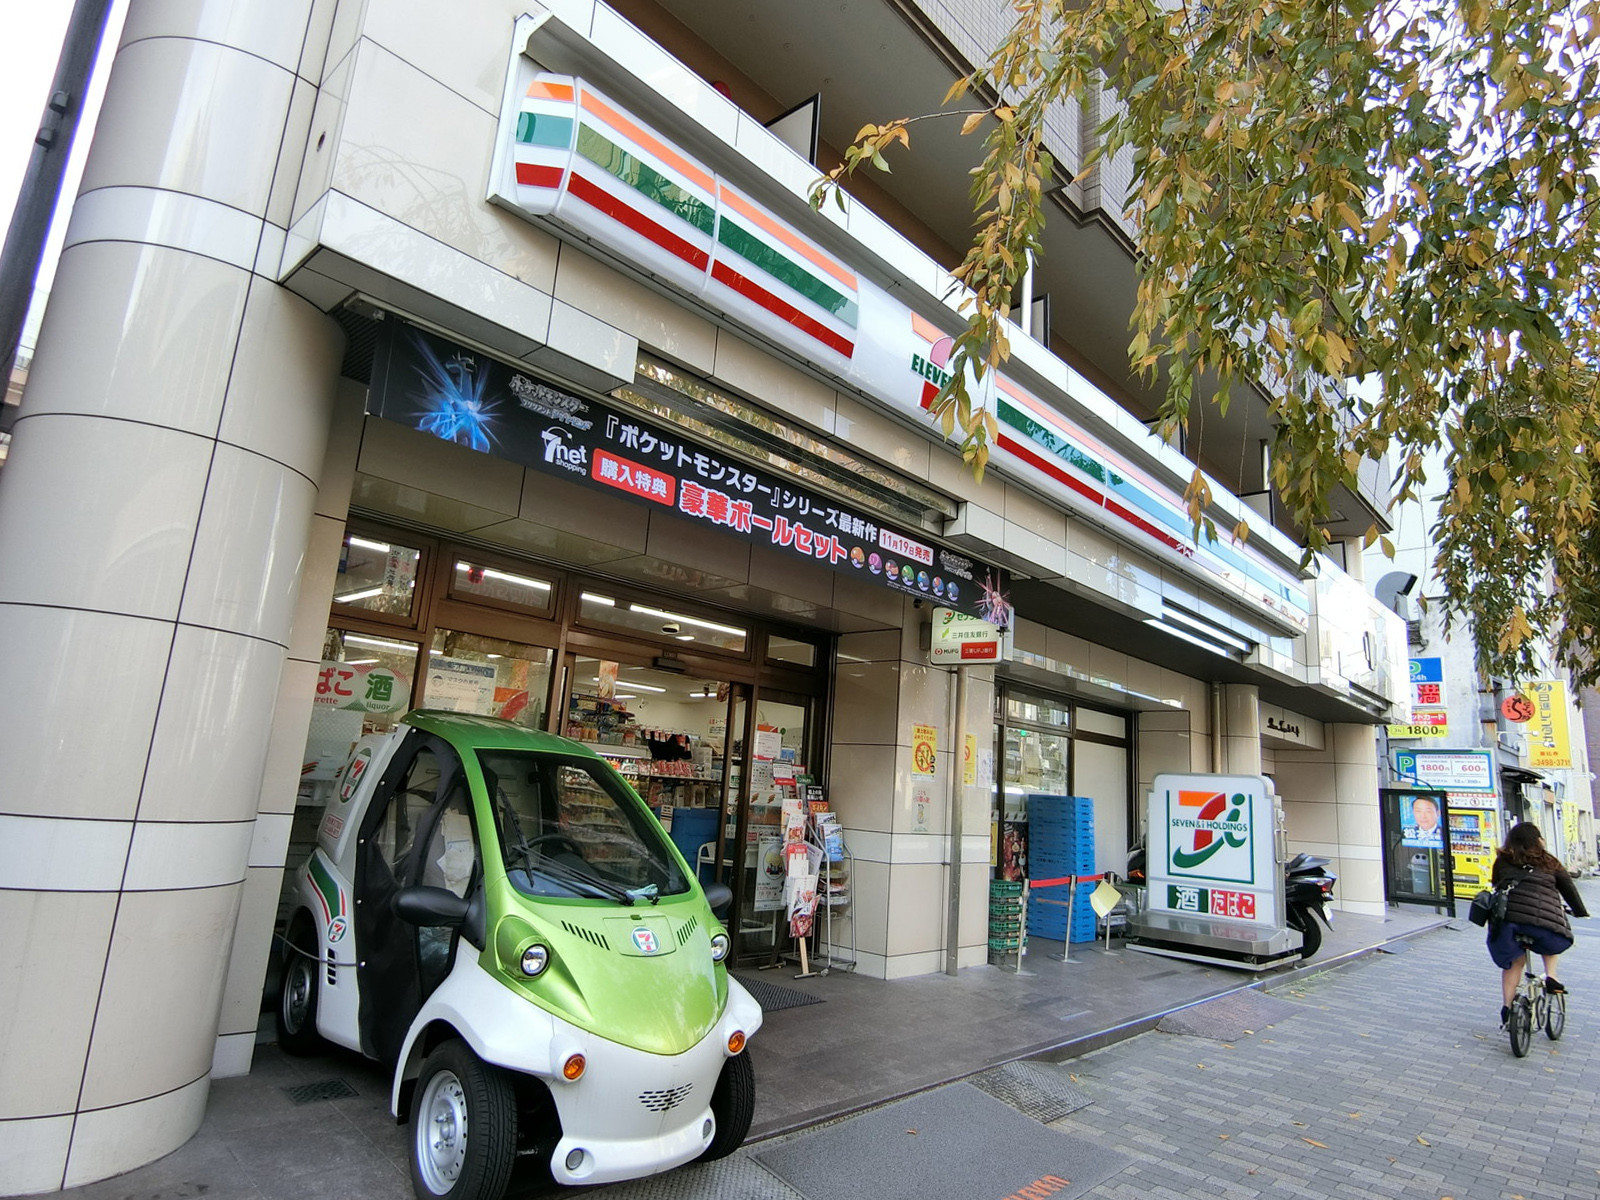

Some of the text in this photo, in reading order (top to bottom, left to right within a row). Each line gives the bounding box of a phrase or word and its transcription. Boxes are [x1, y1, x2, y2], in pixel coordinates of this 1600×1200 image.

[555, 458, 587, 477] shopping
[599, 457, 668, 499] 購入特典
[678, 477, 849, 566] 豪華ボールセット
[882, 532, 932, 563] 11月19日発売
[952, 631, 989, 639] 三井住友銀行
[365, 673, 395, 702] 酒
[1417, 684, 1440, 703] 満
[1206, 821, 1248, 832] HOLDINGS
[1176, 885, 1199, 910] 酒
[1212, 889, 1254, 918] たばこ
